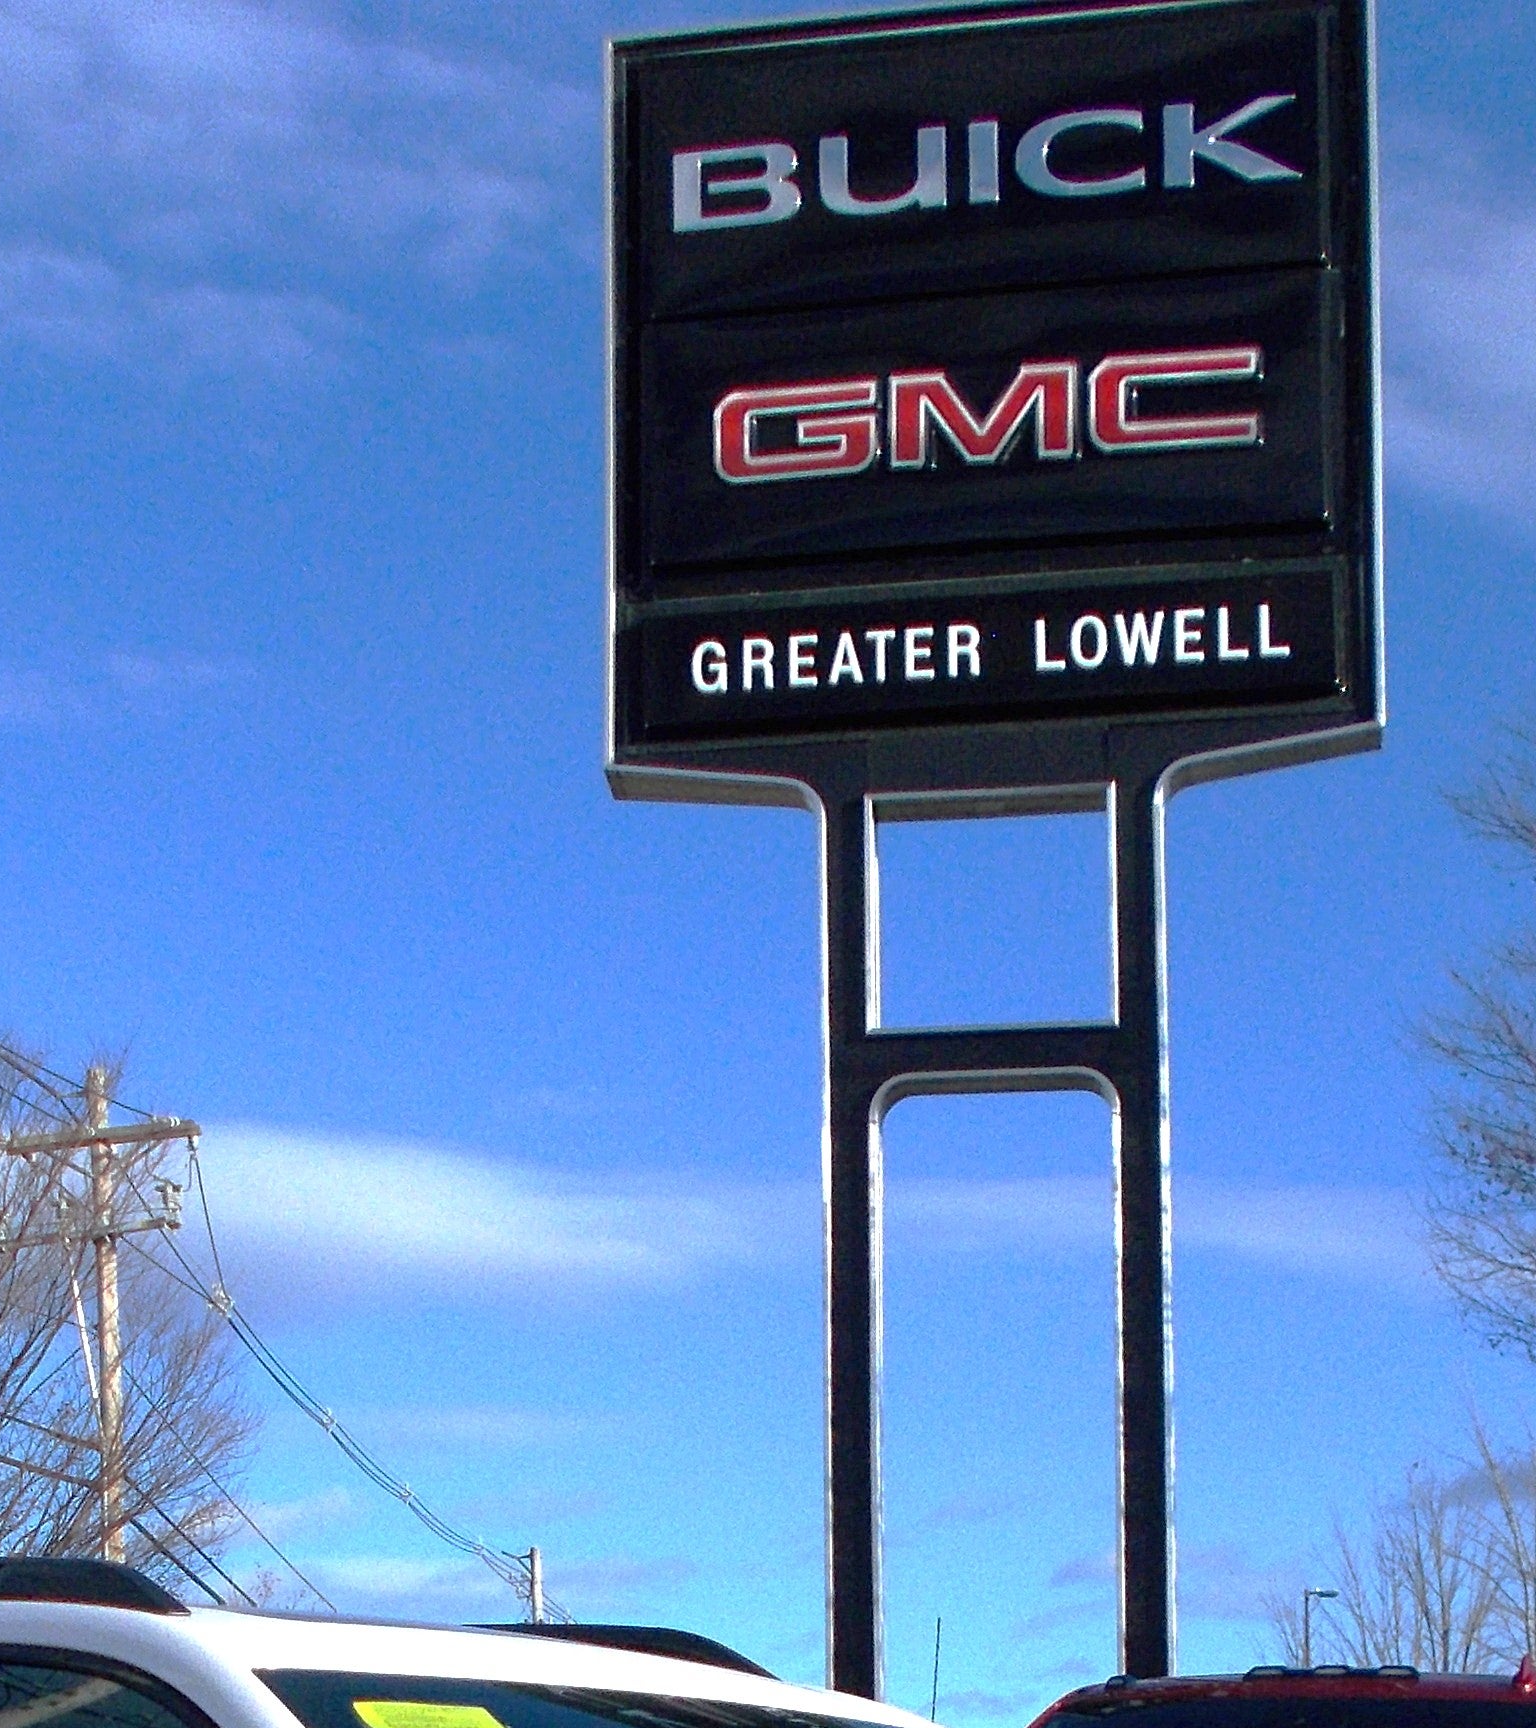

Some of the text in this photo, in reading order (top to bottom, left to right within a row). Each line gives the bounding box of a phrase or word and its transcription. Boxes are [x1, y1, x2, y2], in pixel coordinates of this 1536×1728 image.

[673, 94, 1303, 232] BUICK
[713, 344, 1264, 486] GMC
[691, 603, 1291, 695] GREATER LOWELL
